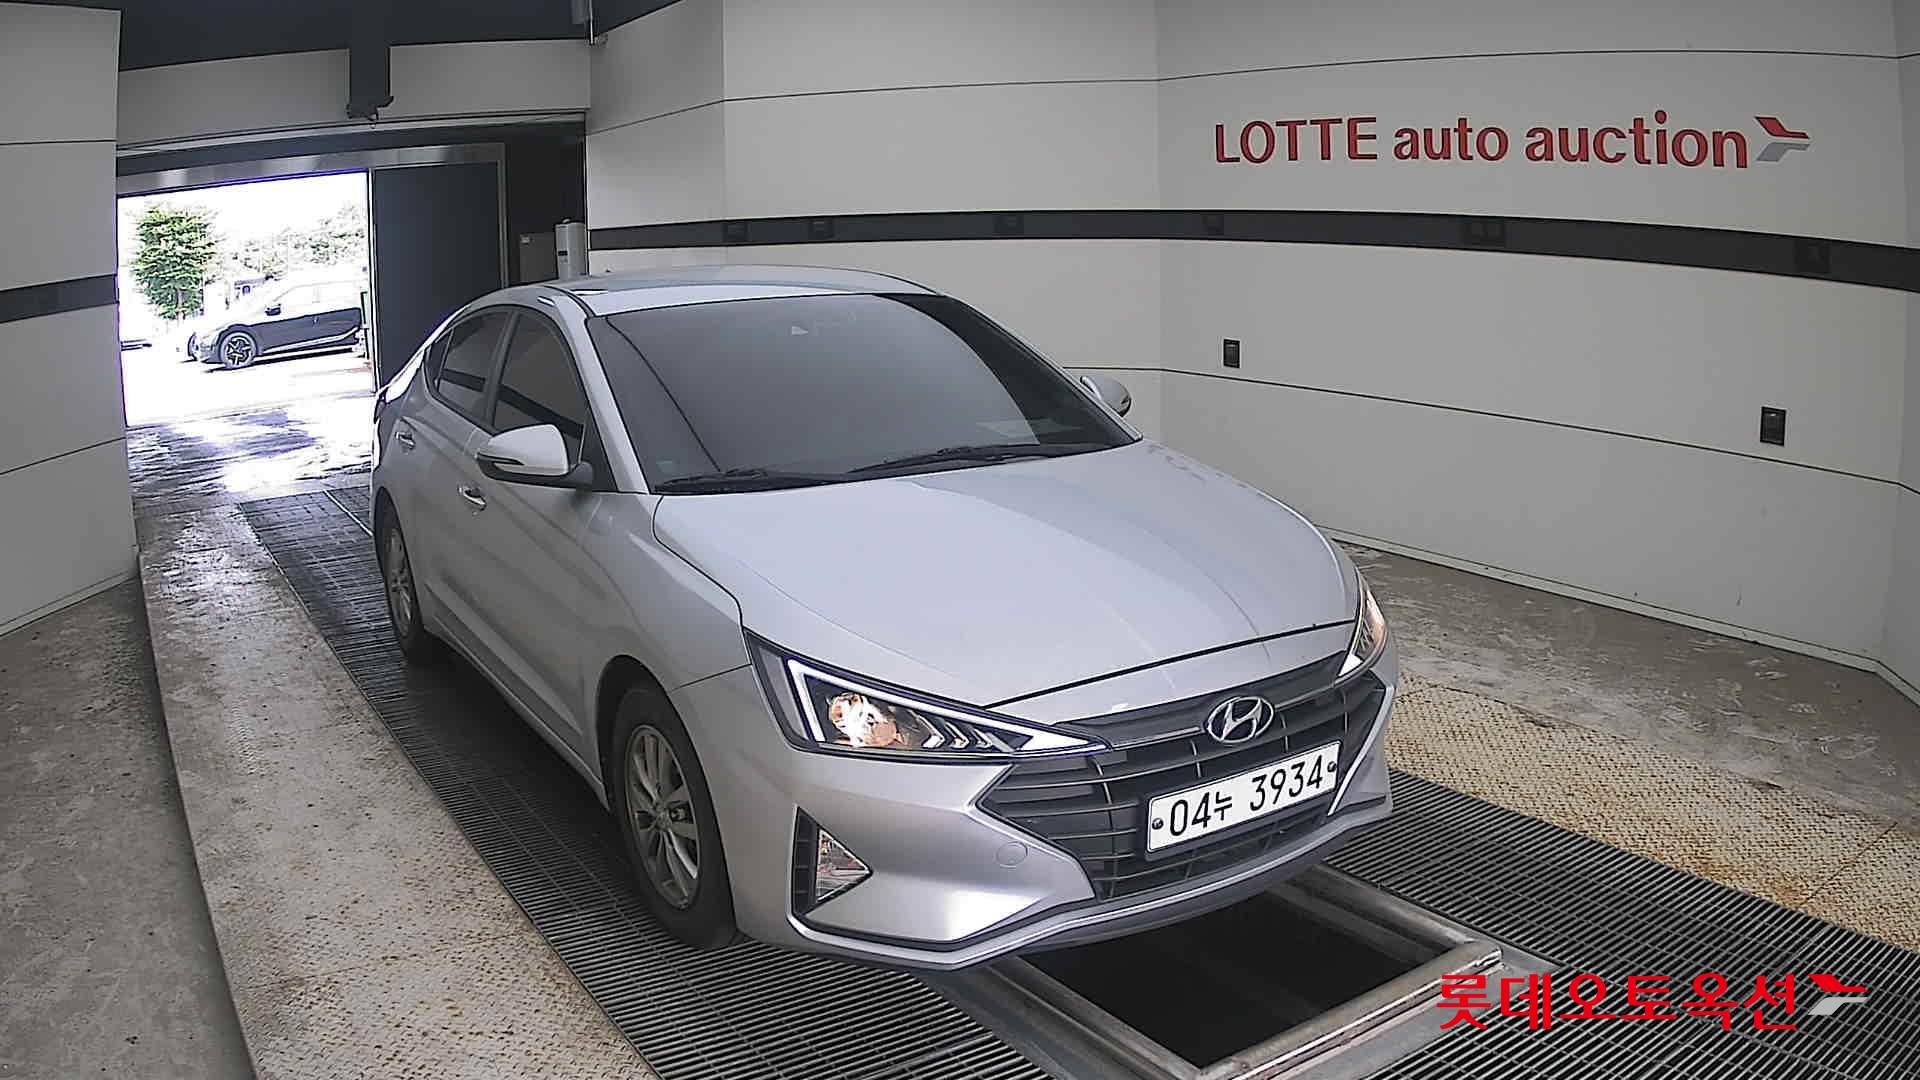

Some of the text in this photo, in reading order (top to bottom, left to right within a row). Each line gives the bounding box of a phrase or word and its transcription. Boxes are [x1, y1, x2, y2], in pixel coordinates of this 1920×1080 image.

[1215, 109, 1749, 169] LOTTE auto auction
[1169, 754, 1323, 837] 04누 3934
